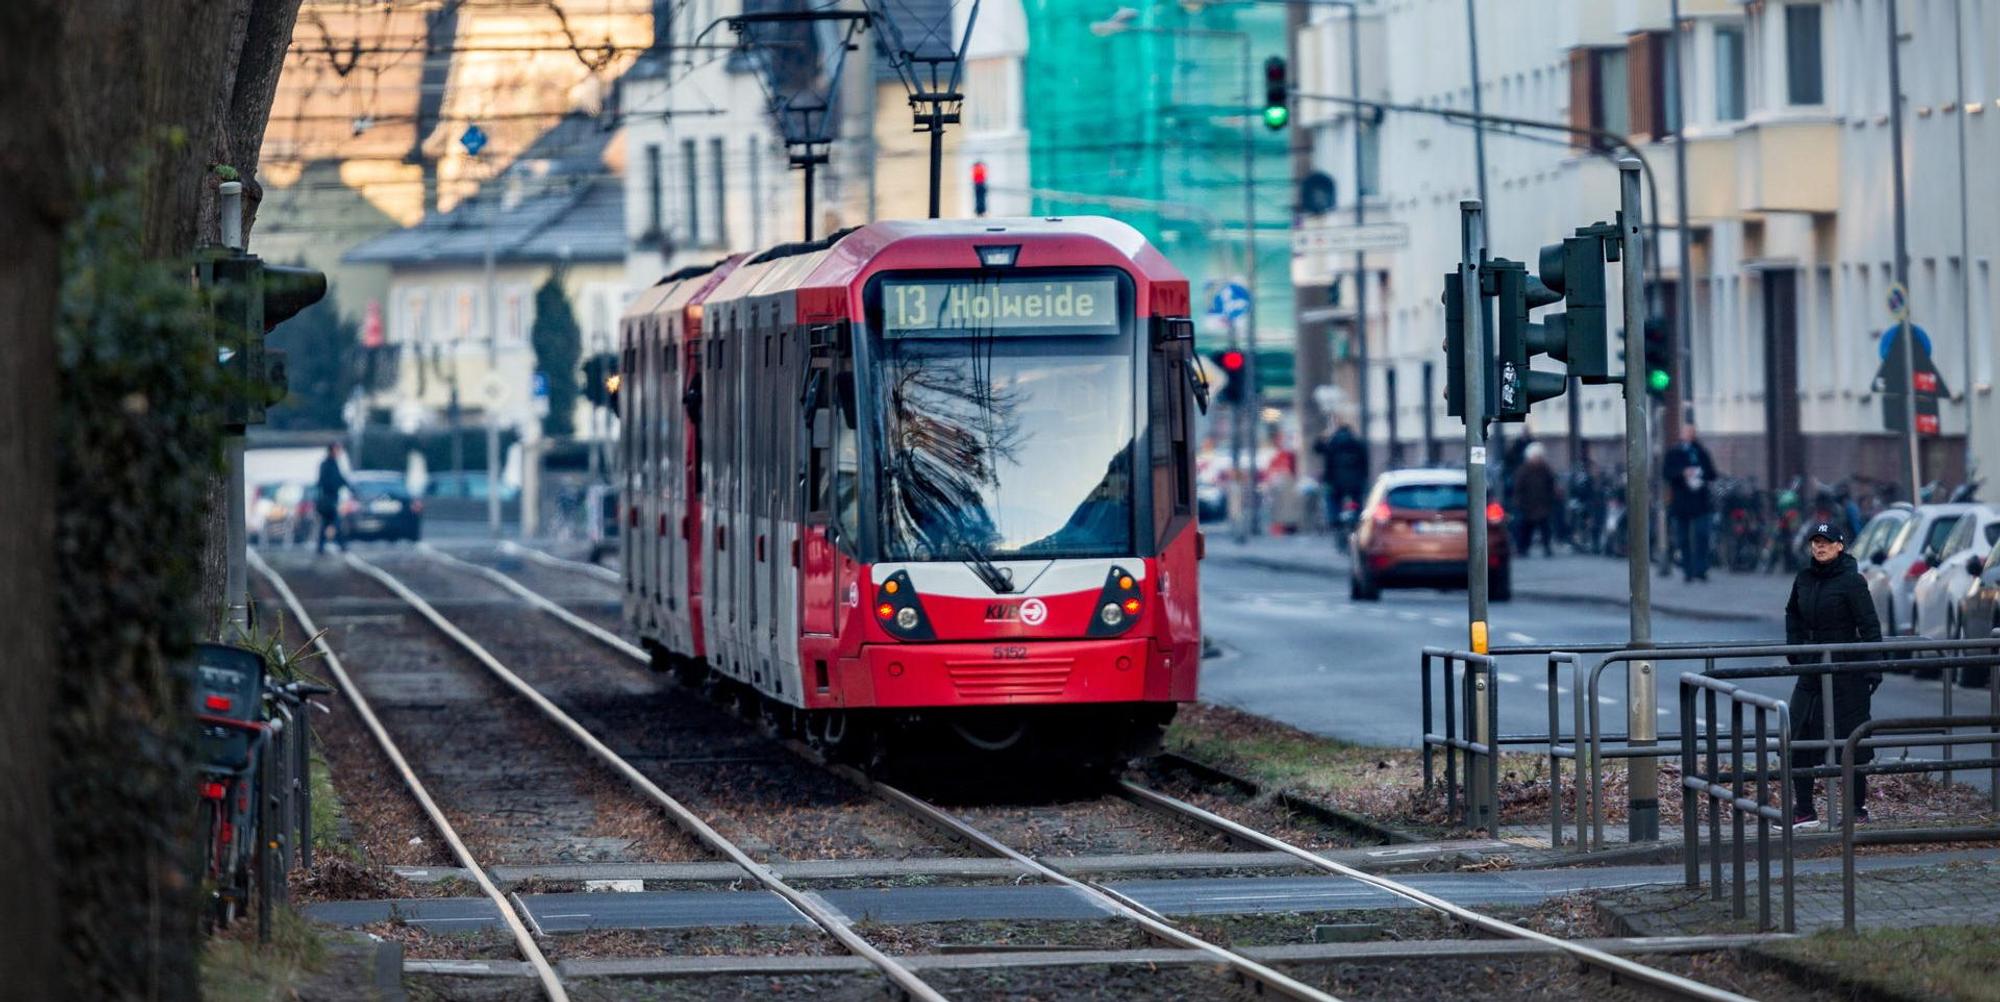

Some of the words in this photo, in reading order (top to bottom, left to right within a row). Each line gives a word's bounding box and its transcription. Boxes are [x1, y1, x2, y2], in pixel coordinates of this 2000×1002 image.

[895, 286, 926, 325] 13
[950, 285, 1094, 319] Holweide
[992, 646, 1027, 660] 5152
